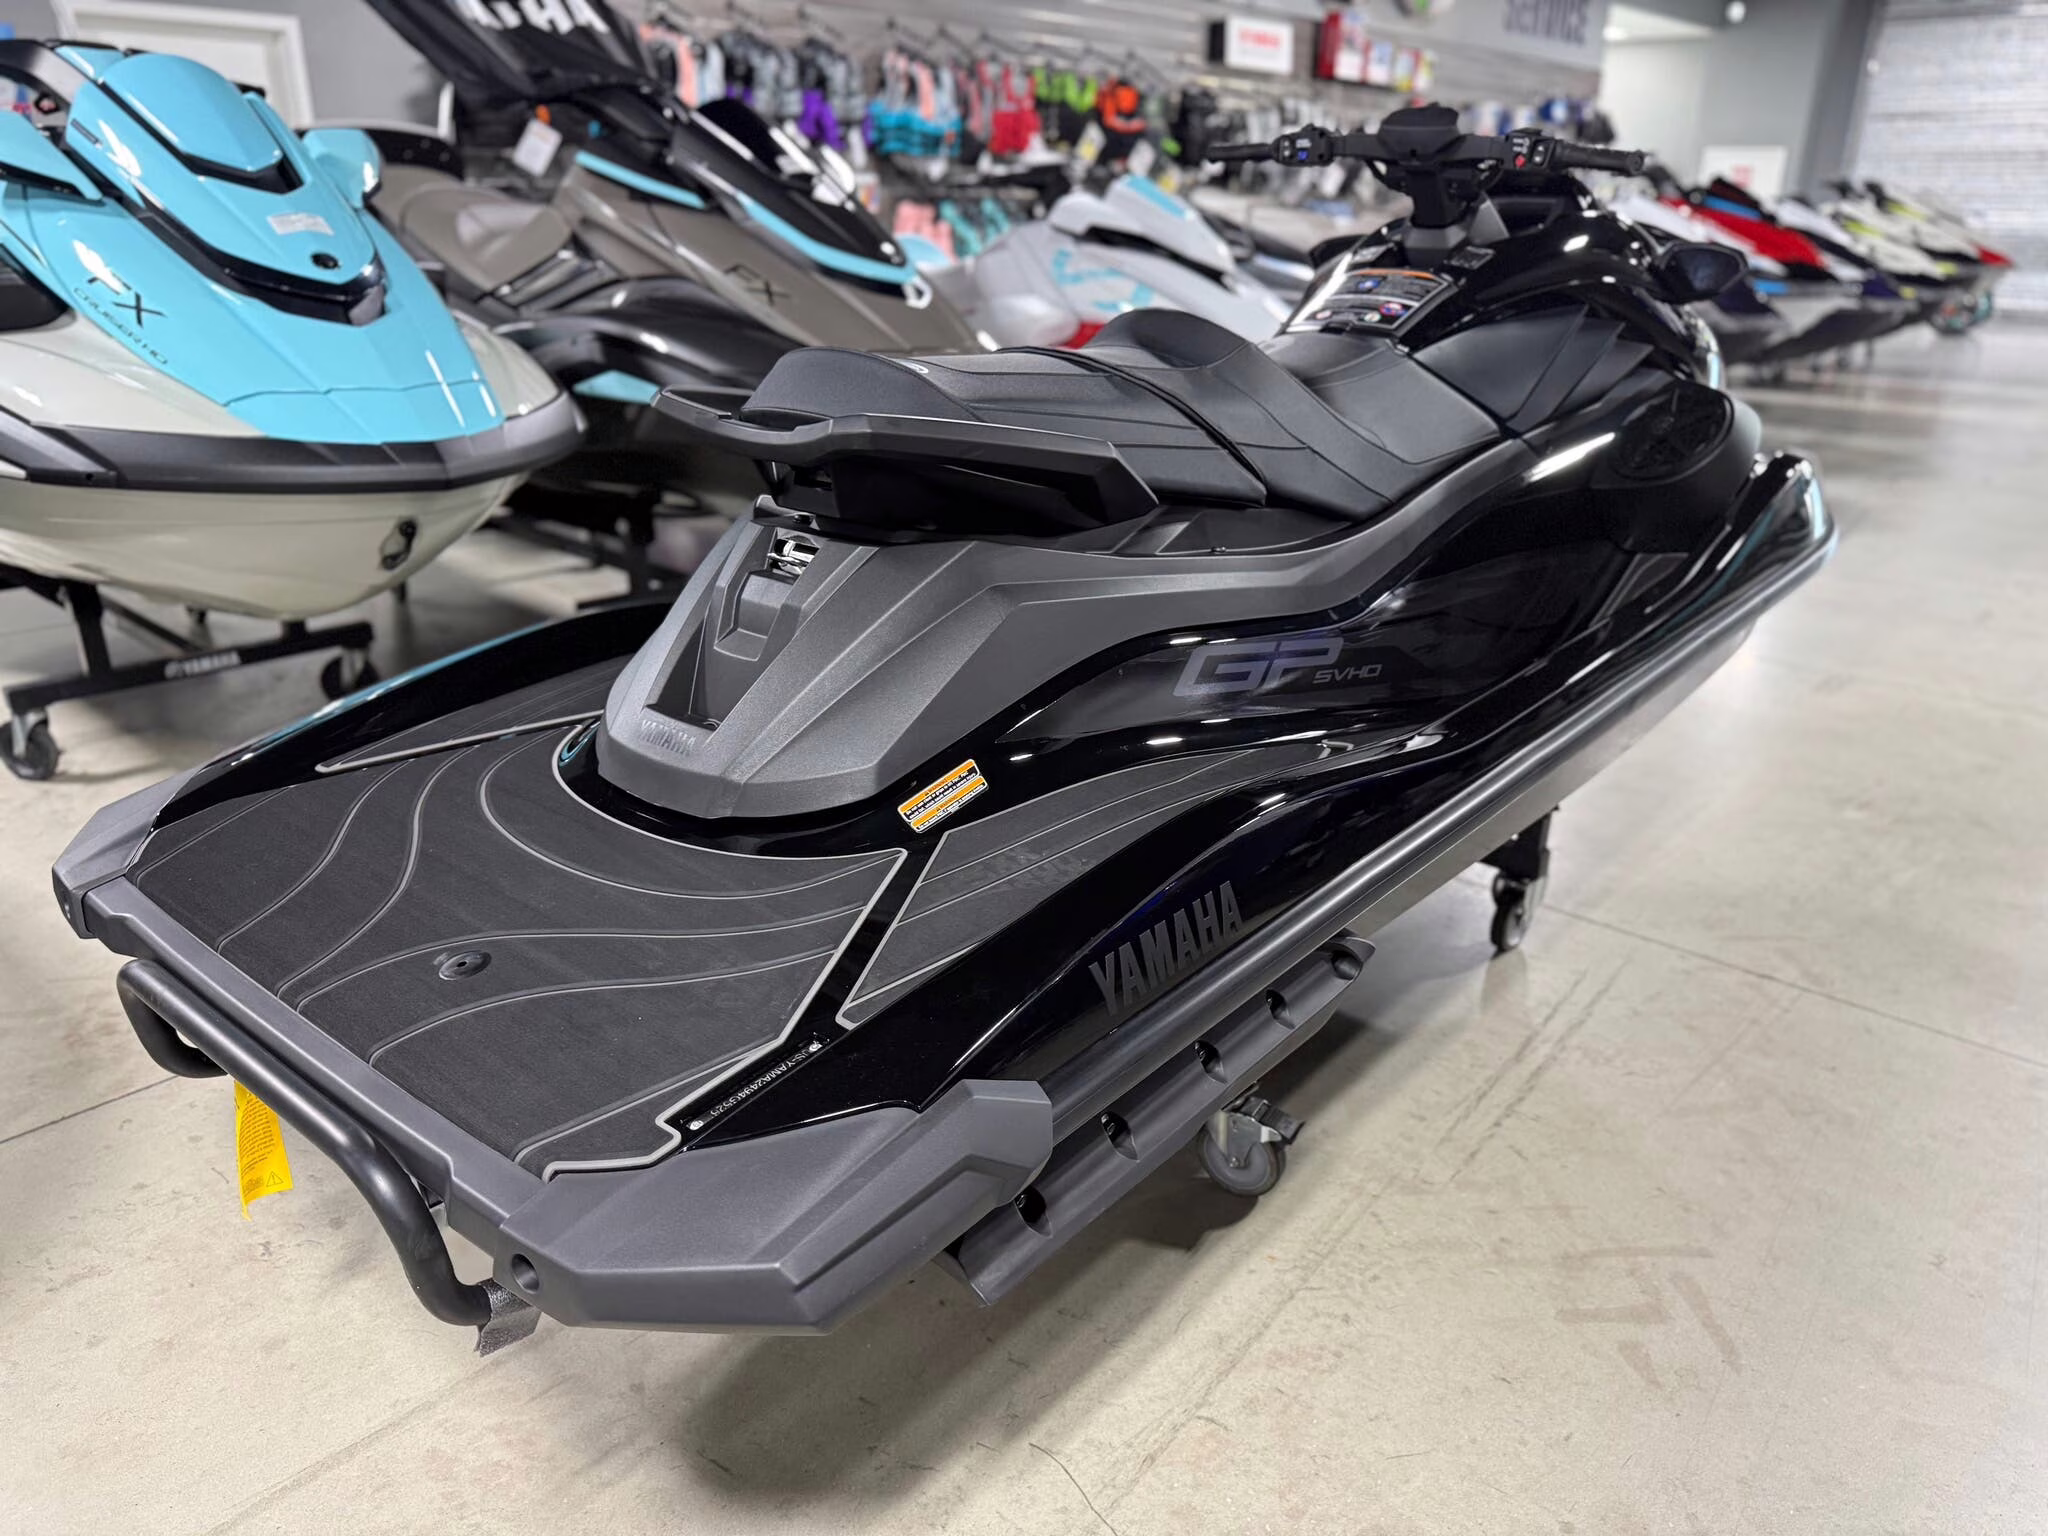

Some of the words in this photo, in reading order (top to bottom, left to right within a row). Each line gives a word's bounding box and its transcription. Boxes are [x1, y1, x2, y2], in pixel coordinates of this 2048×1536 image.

[723, 263, 793, 307] FX
[1173, 637, 1344, 696] GP
[1312, 664, 1383, 684] SVHO
[640, 719, 697, 756] YAMAHA
[1088, 880, 1243, 1017] YAMAHA
